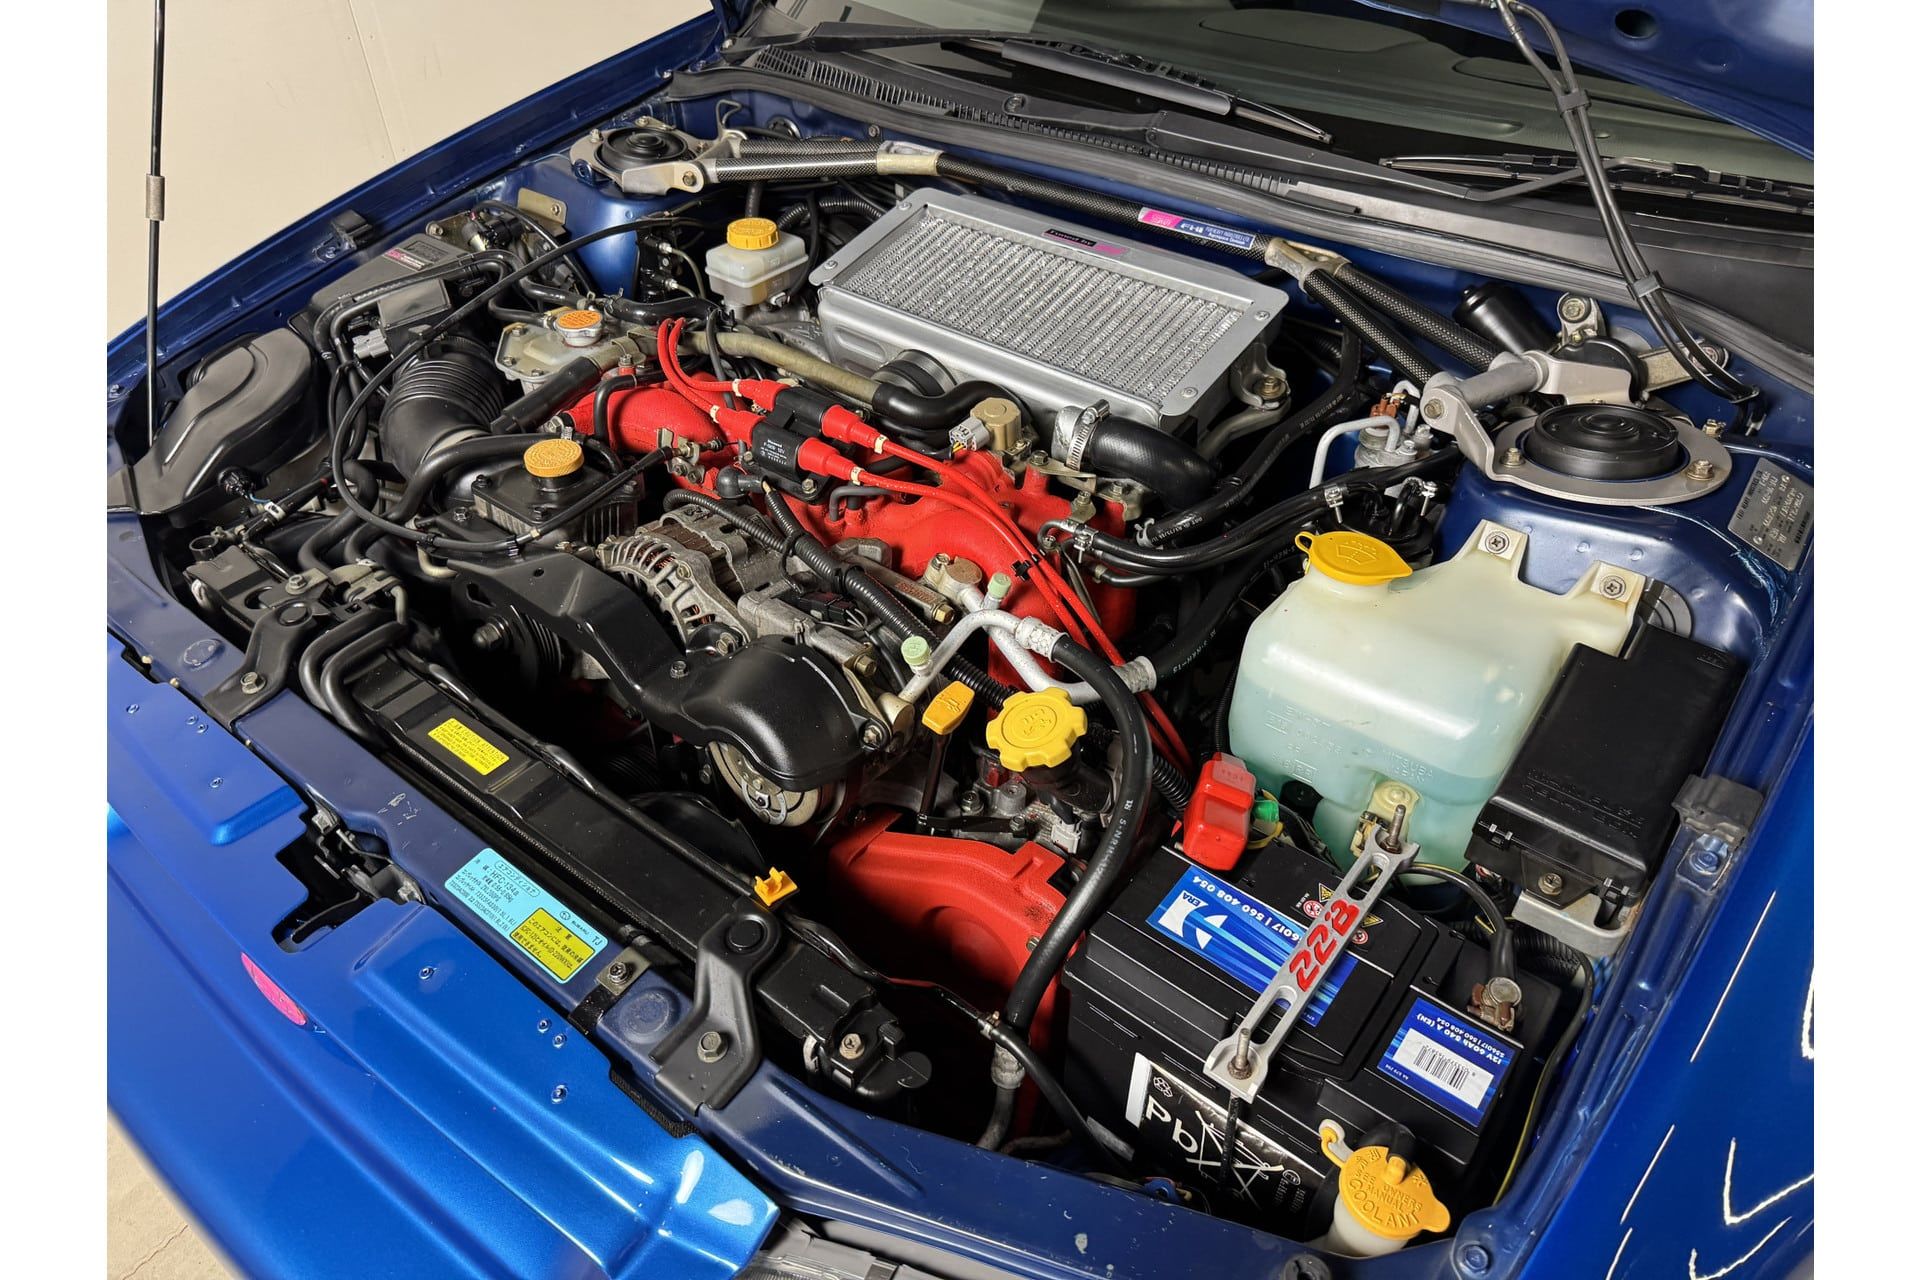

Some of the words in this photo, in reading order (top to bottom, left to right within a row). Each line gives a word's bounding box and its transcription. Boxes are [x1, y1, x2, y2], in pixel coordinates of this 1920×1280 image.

[1191, 874, 1216, 892] 054
[1181, 891, 1202, 906] ERA
[1215, 888, 1241, 907] 408
[1240, 902, 1265, 921] 560
[1271, 921, 1303, 943] 6017
[591, 936, 602, 946] TJ
[1415, 1012, 1435, 1026] (EN)
[1436, 1016, 1450, 1027] 054
[1435, 1023, 1443, 1031] A
[1444, 1028, 1462, 1041] 540
[1449, 1024, 1464, 1035] 408
[1463, 1031, 1478, 1042] 560
[1461, 1038, 1485, 1055] 60Ah
[1486, 1052, 1502, 1064] 12V
[1145, 1094, 1198, 1152] Pb
[1350, 1178, 1418, 1227] COOLANT
[1365, 1184, 1404, 1212] MANUAL
